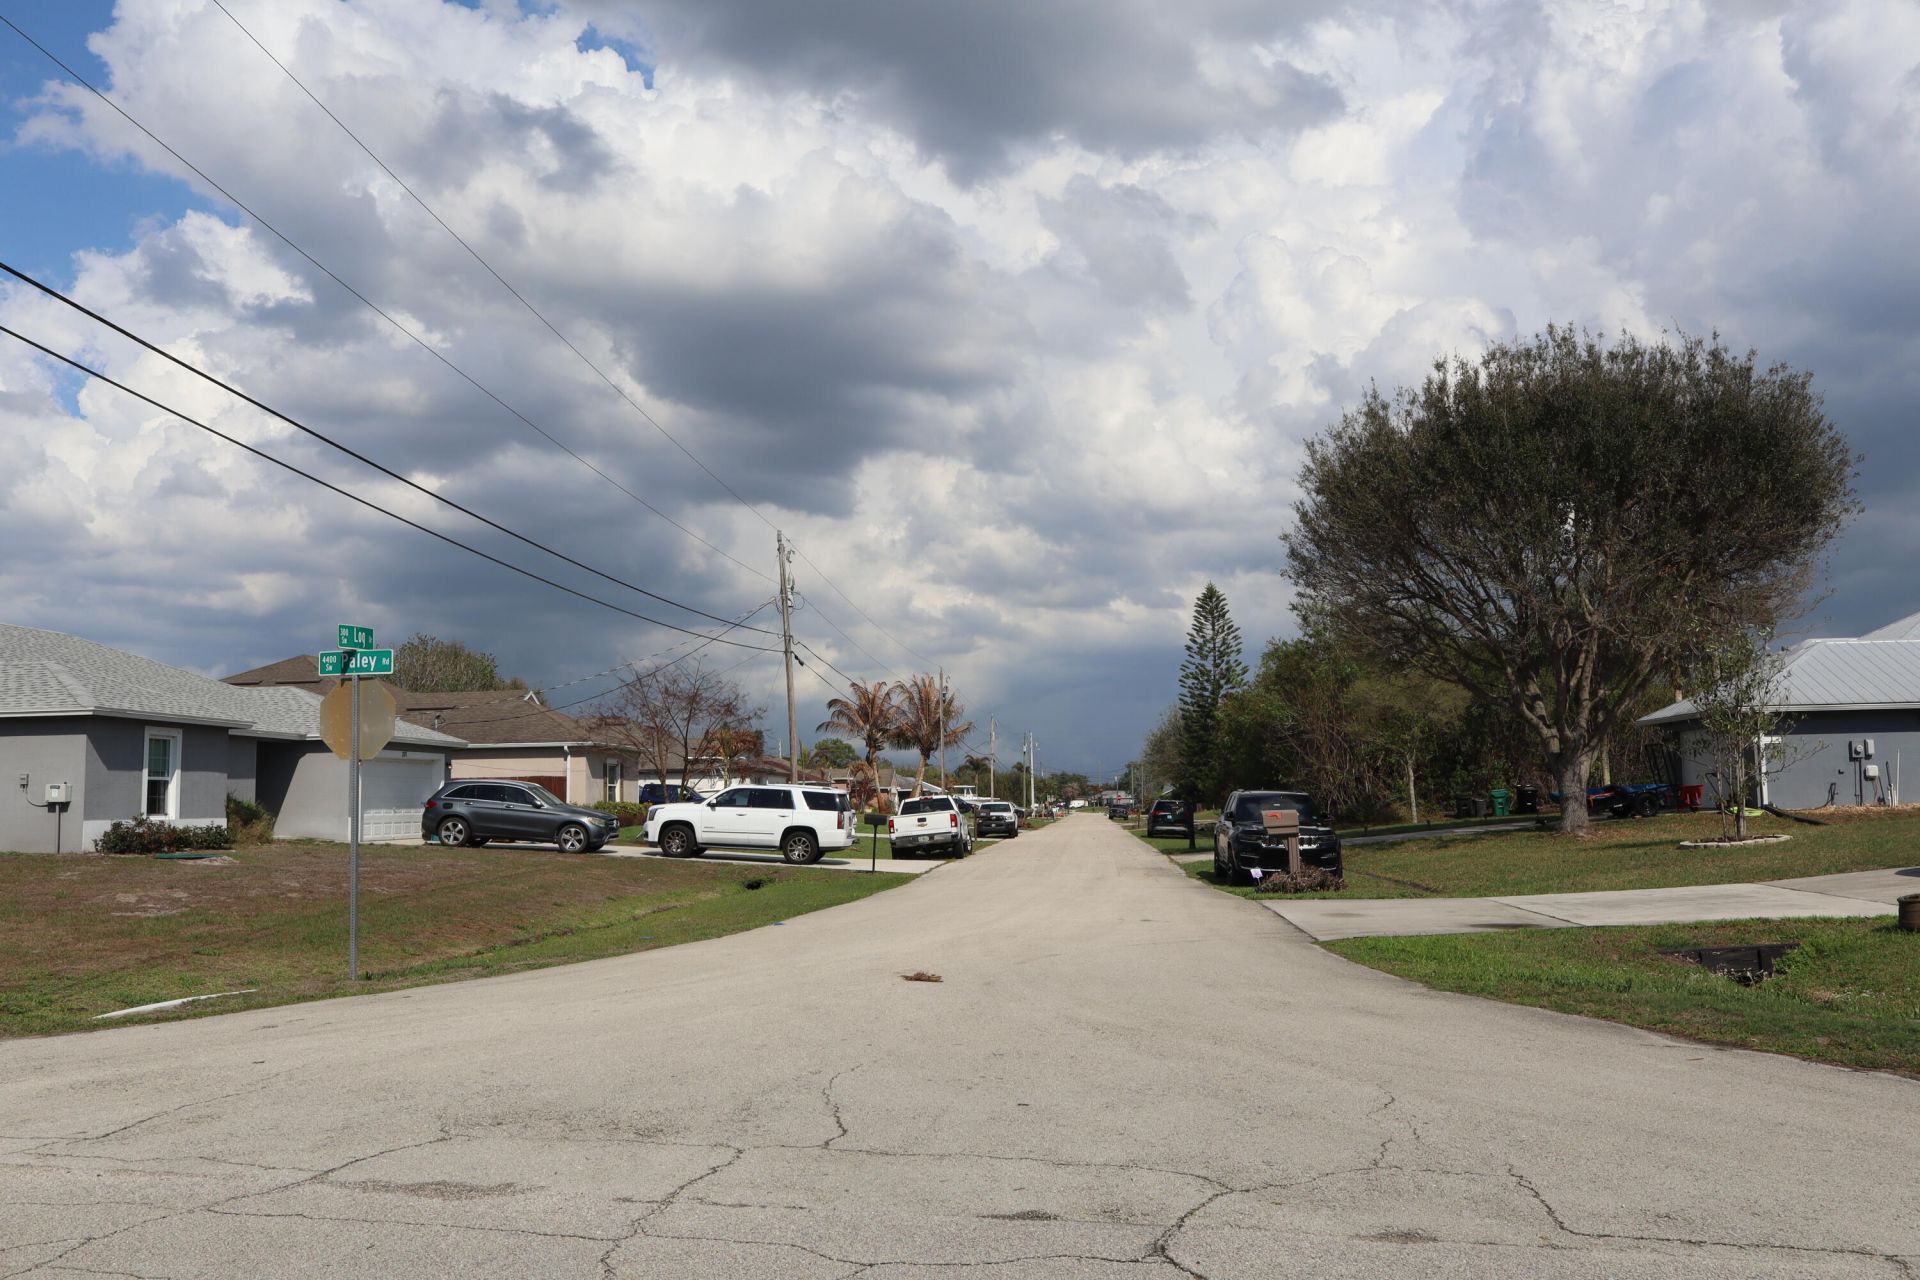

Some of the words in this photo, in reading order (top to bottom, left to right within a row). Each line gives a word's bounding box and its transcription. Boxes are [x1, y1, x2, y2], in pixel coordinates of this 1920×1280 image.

[354, 627, 366, 648] Log
[322, 656, 336, 664] 4400
[342, 652, 376, 671] Paley
[382, 657, 390, 665] Rd
